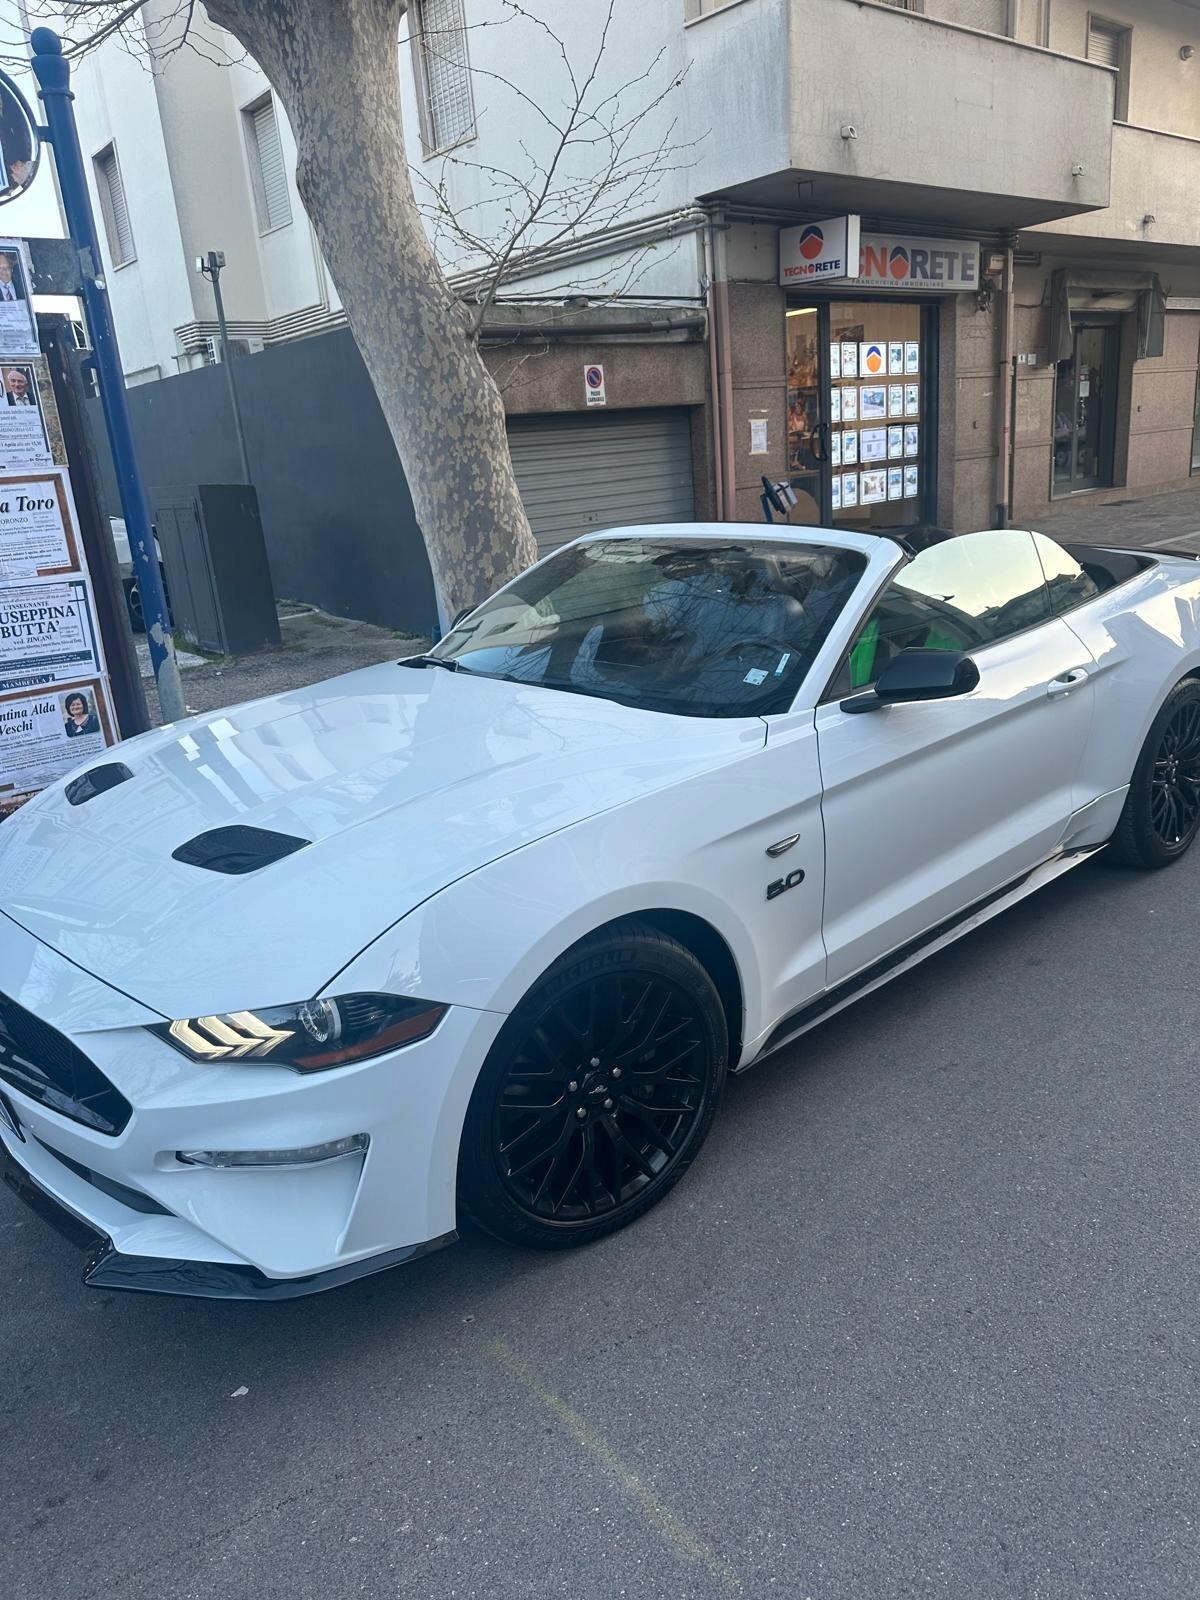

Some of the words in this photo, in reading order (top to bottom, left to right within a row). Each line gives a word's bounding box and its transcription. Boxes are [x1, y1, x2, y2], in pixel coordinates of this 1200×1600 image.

[784, 260, 841, 277] TECNORETE
[16, 496, 55, 512] Toro
[3, 601, 50, 611] L'INSEGNANTE
[1, 620, 60, 639] BUTTA'
[2, 679, 47, 689] MAMBELLA
[31, 703, 56, 717] Alda
[767, 869, 805, 900] 5.0
